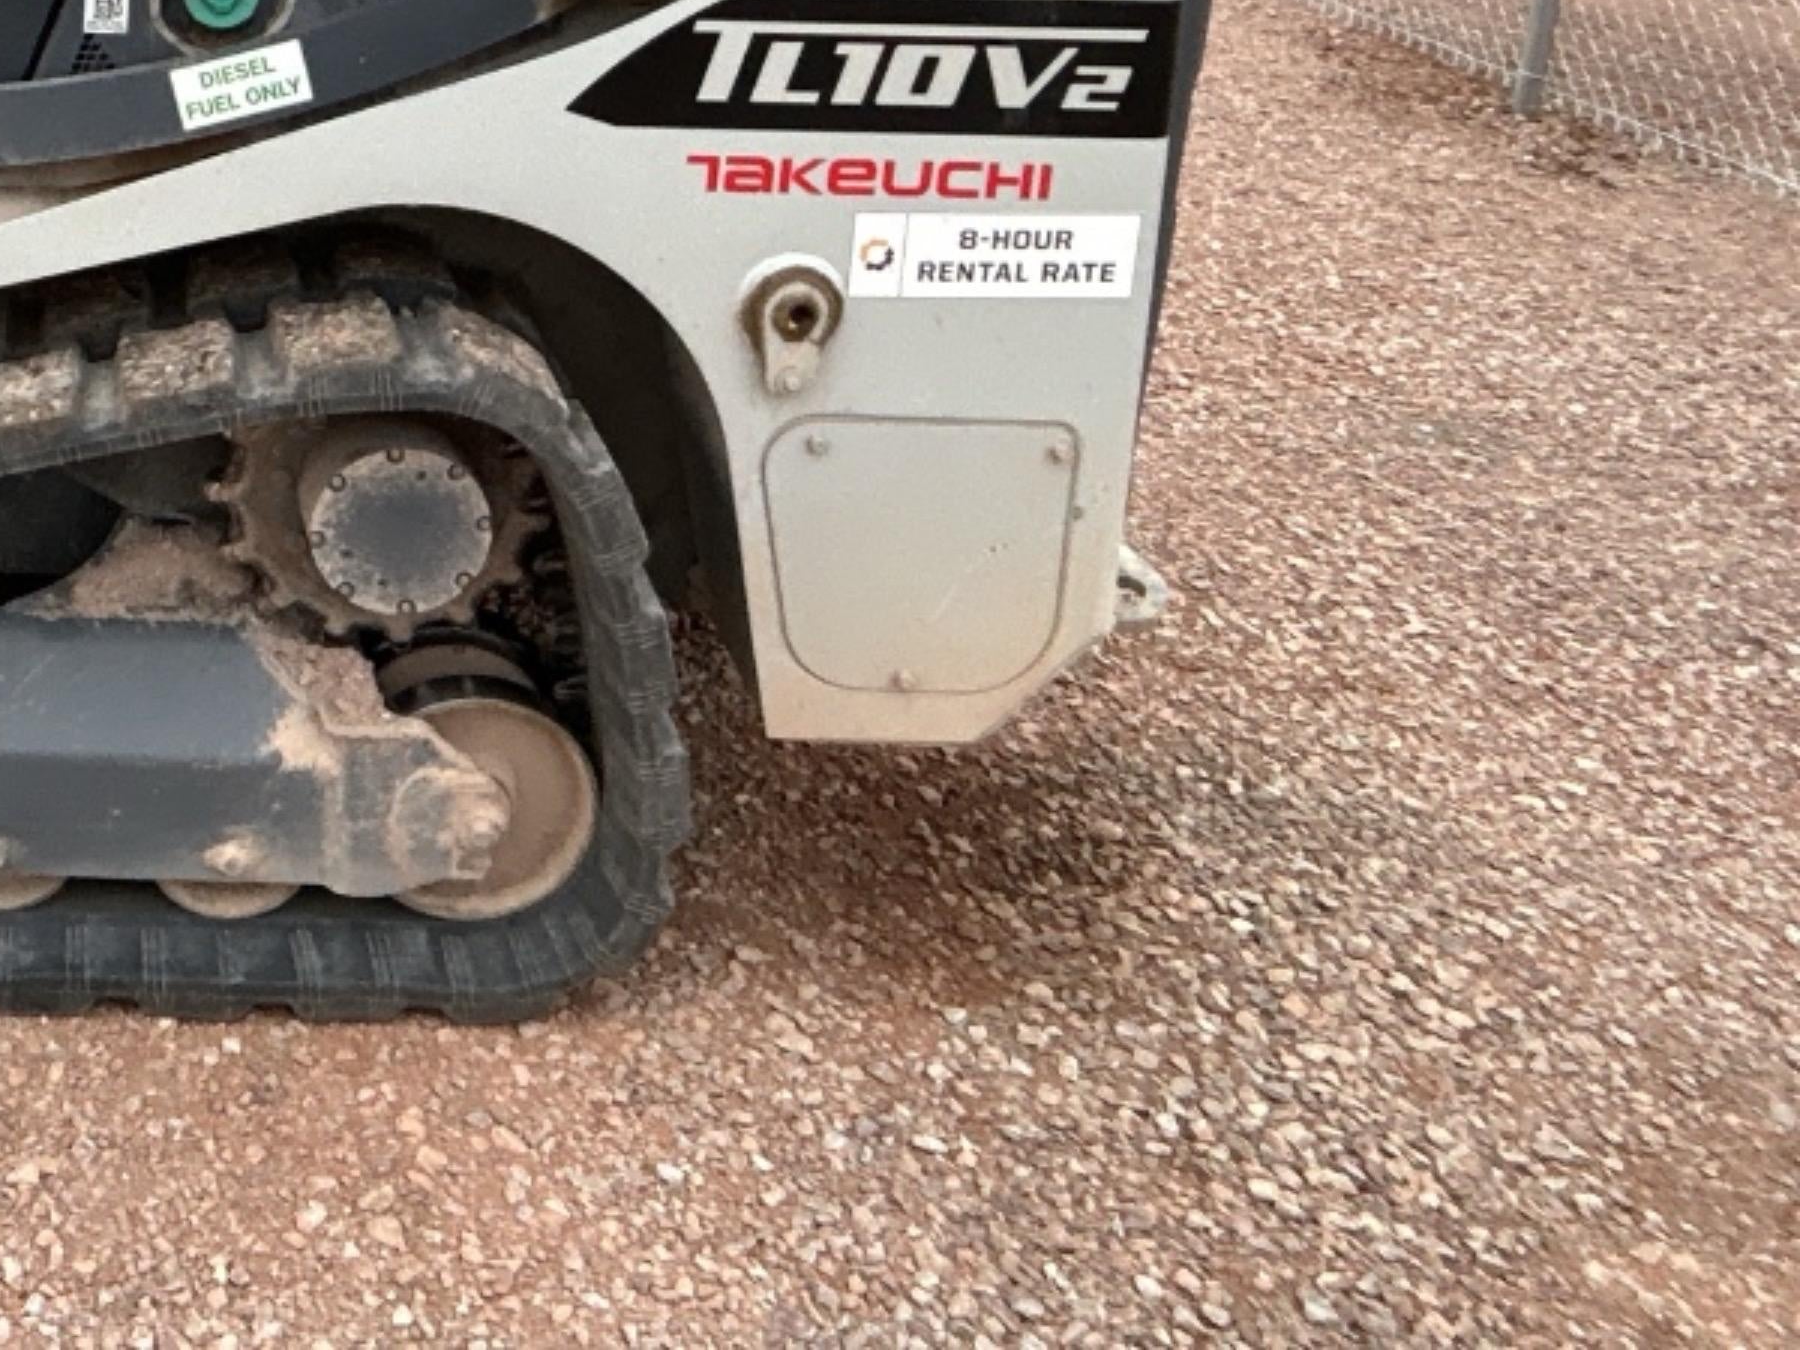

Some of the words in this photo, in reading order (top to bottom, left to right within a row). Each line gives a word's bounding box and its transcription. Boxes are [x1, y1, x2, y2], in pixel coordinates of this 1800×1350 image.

[199, 56, 276, 90] DIESEL
[693, 20, 1149, 111] TL10V2
[186, 93, 242, 120] FUEL
[245, 75, 301, 105] ONLY
[958, 229, 1074, 250] 8-HOUR
[916, 261, 1029, 284] RENTAL
[1040, 262, 1117, 284] RATE
